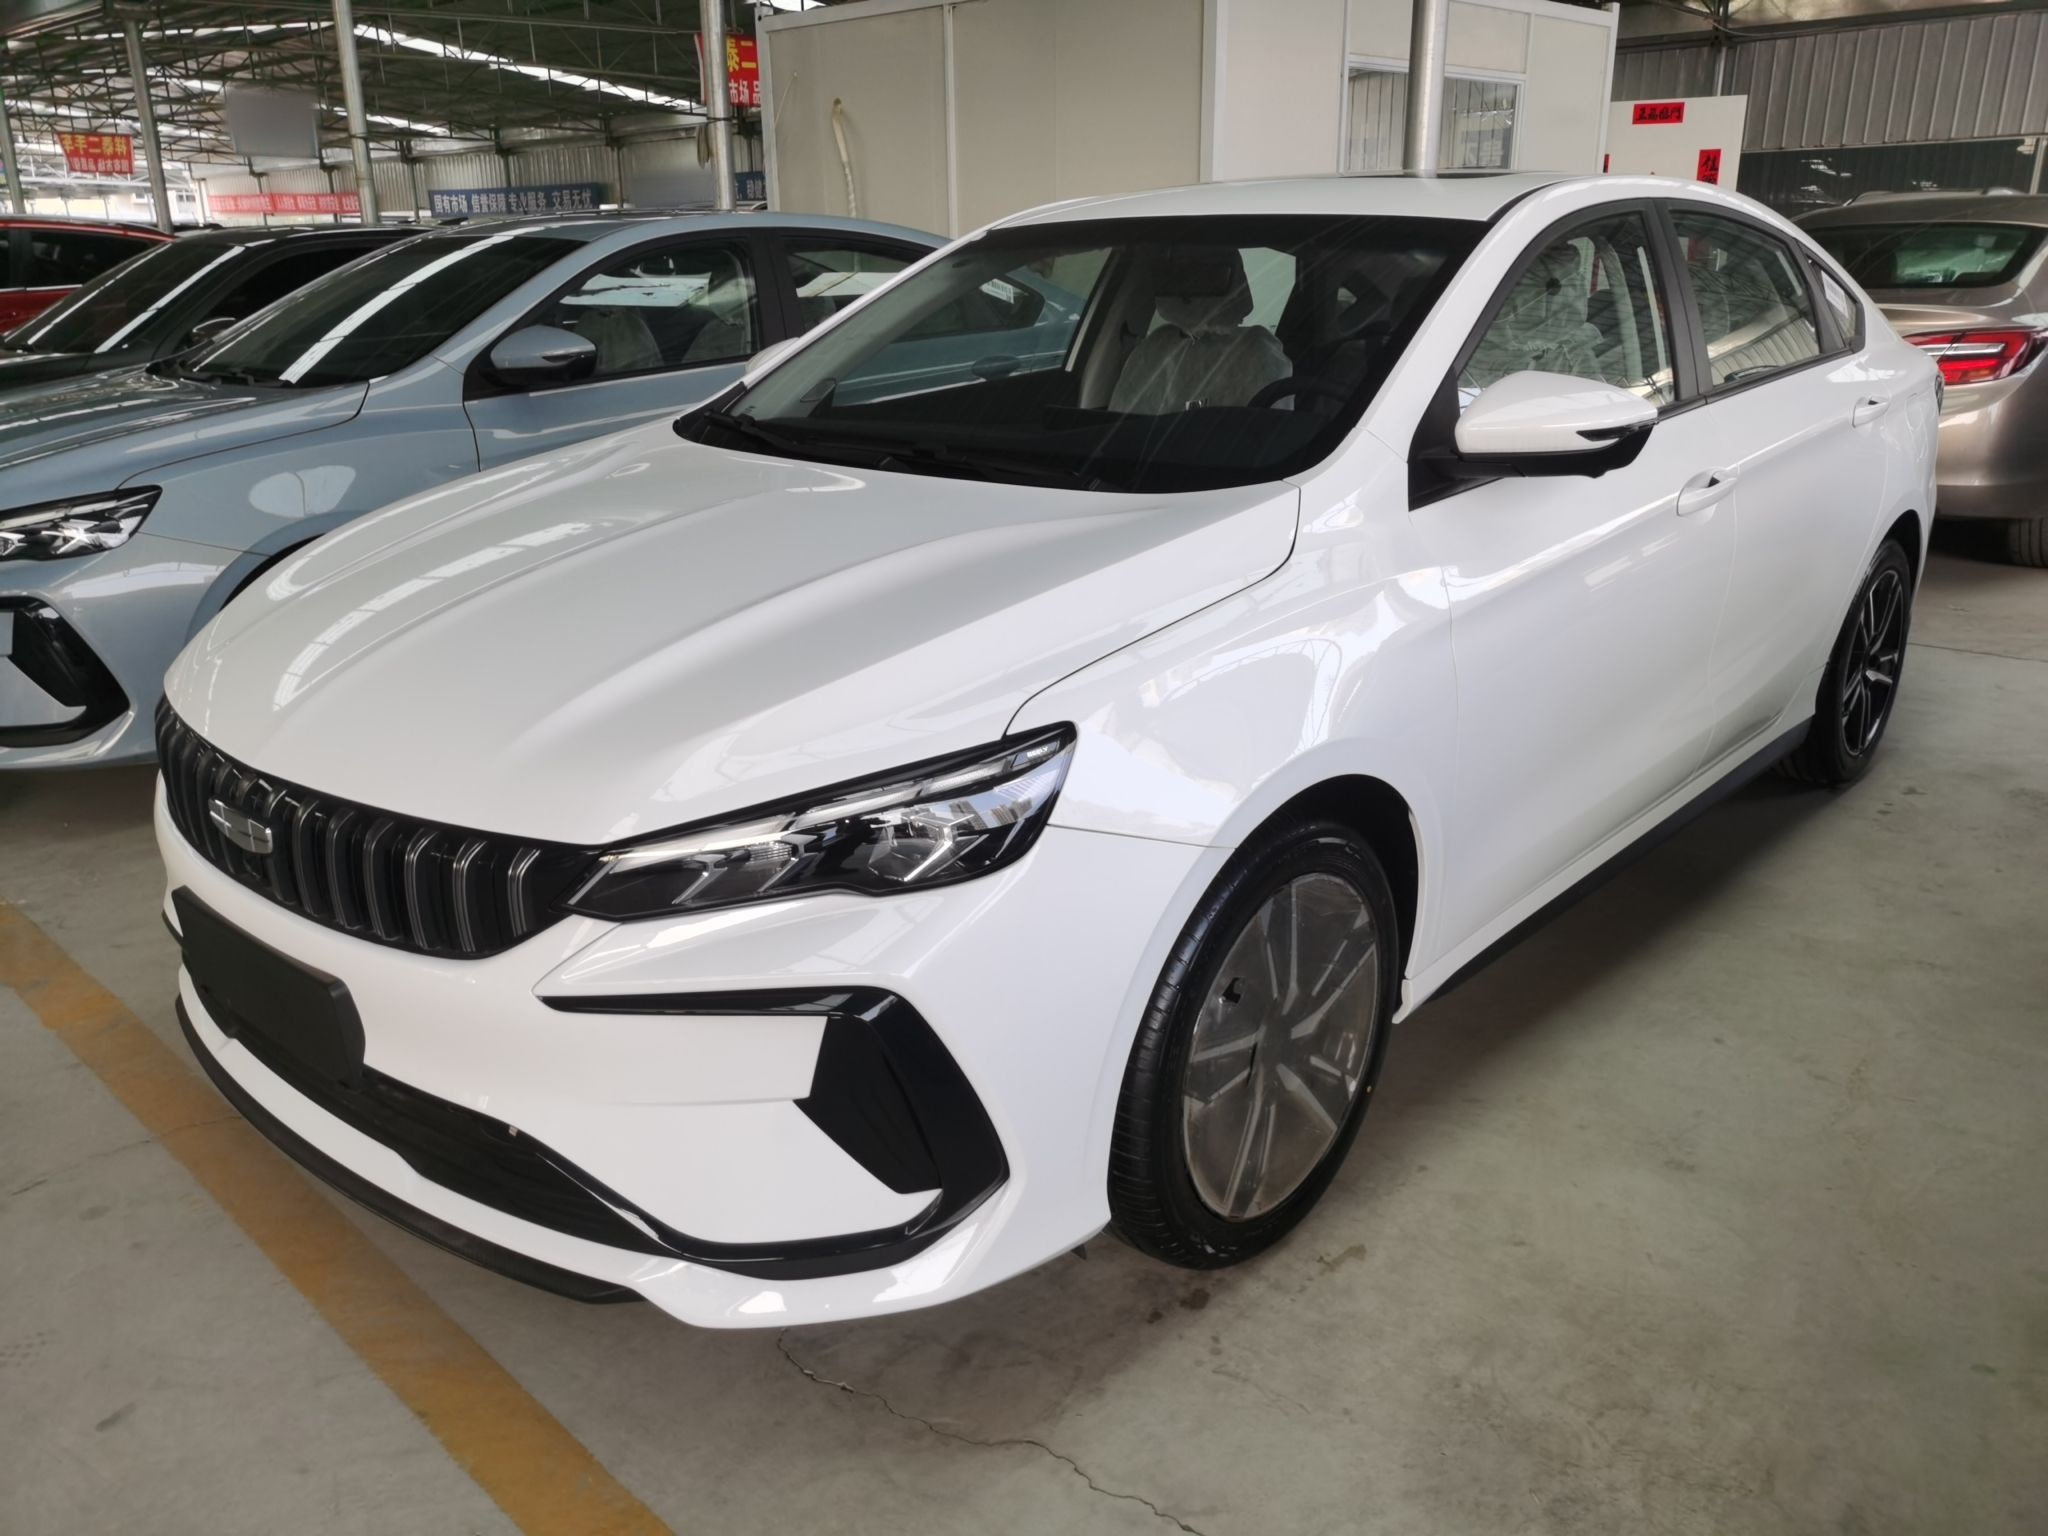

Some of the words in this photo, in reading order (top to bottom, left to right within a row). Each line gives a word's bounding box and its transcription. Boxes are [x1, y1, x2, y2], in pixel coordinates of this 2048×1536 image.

[434, 194, 468, 213] 国有市场
[472, 193, 507, 213] 信誉保障
[508, 191, 546, 212] 专业服务
[552, 188, 593, 211] 交易无忧
